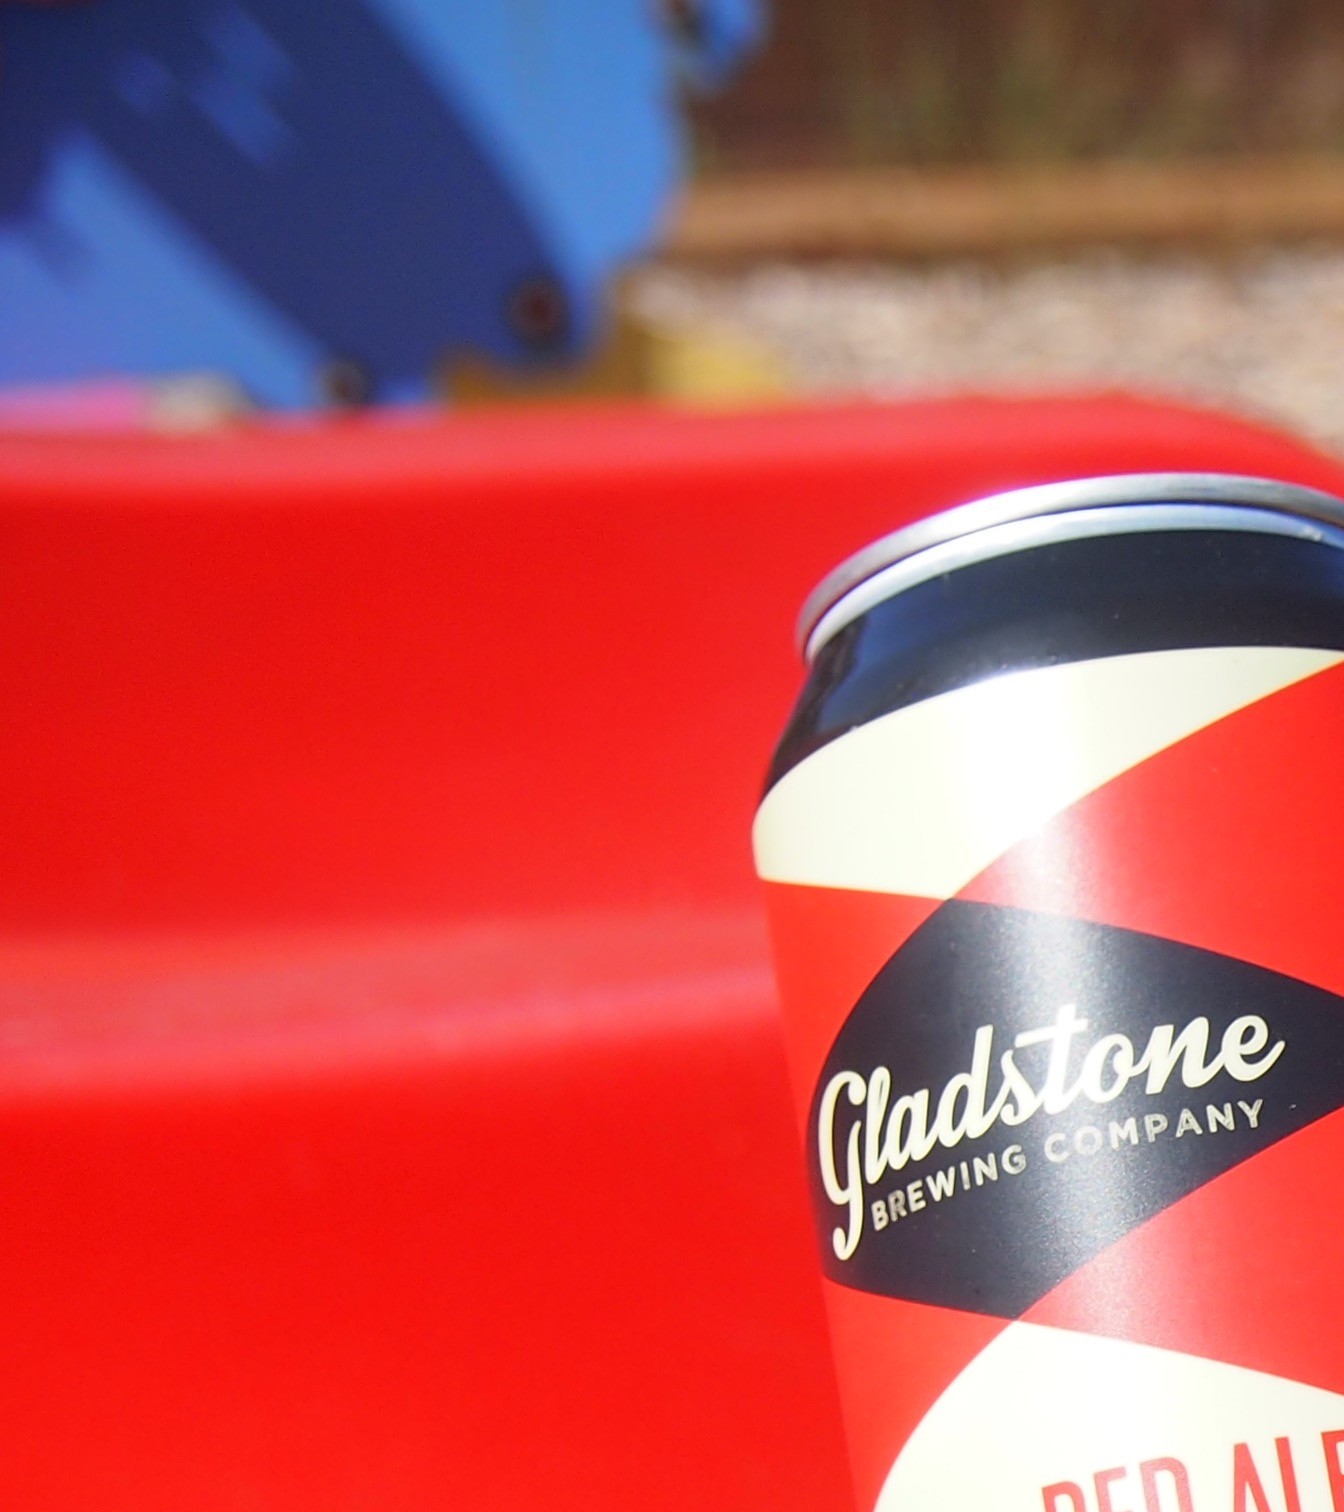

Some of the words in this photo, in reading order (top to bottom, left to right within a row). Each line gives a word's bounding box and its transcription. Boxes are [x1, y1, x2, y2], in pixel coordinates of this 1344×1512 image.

[818, 1003, 1286, 1261] Gladstone
[870, 1144, 1027, 1232] BREWING
[1043, 1098, 1264, 1164] COMPANY
